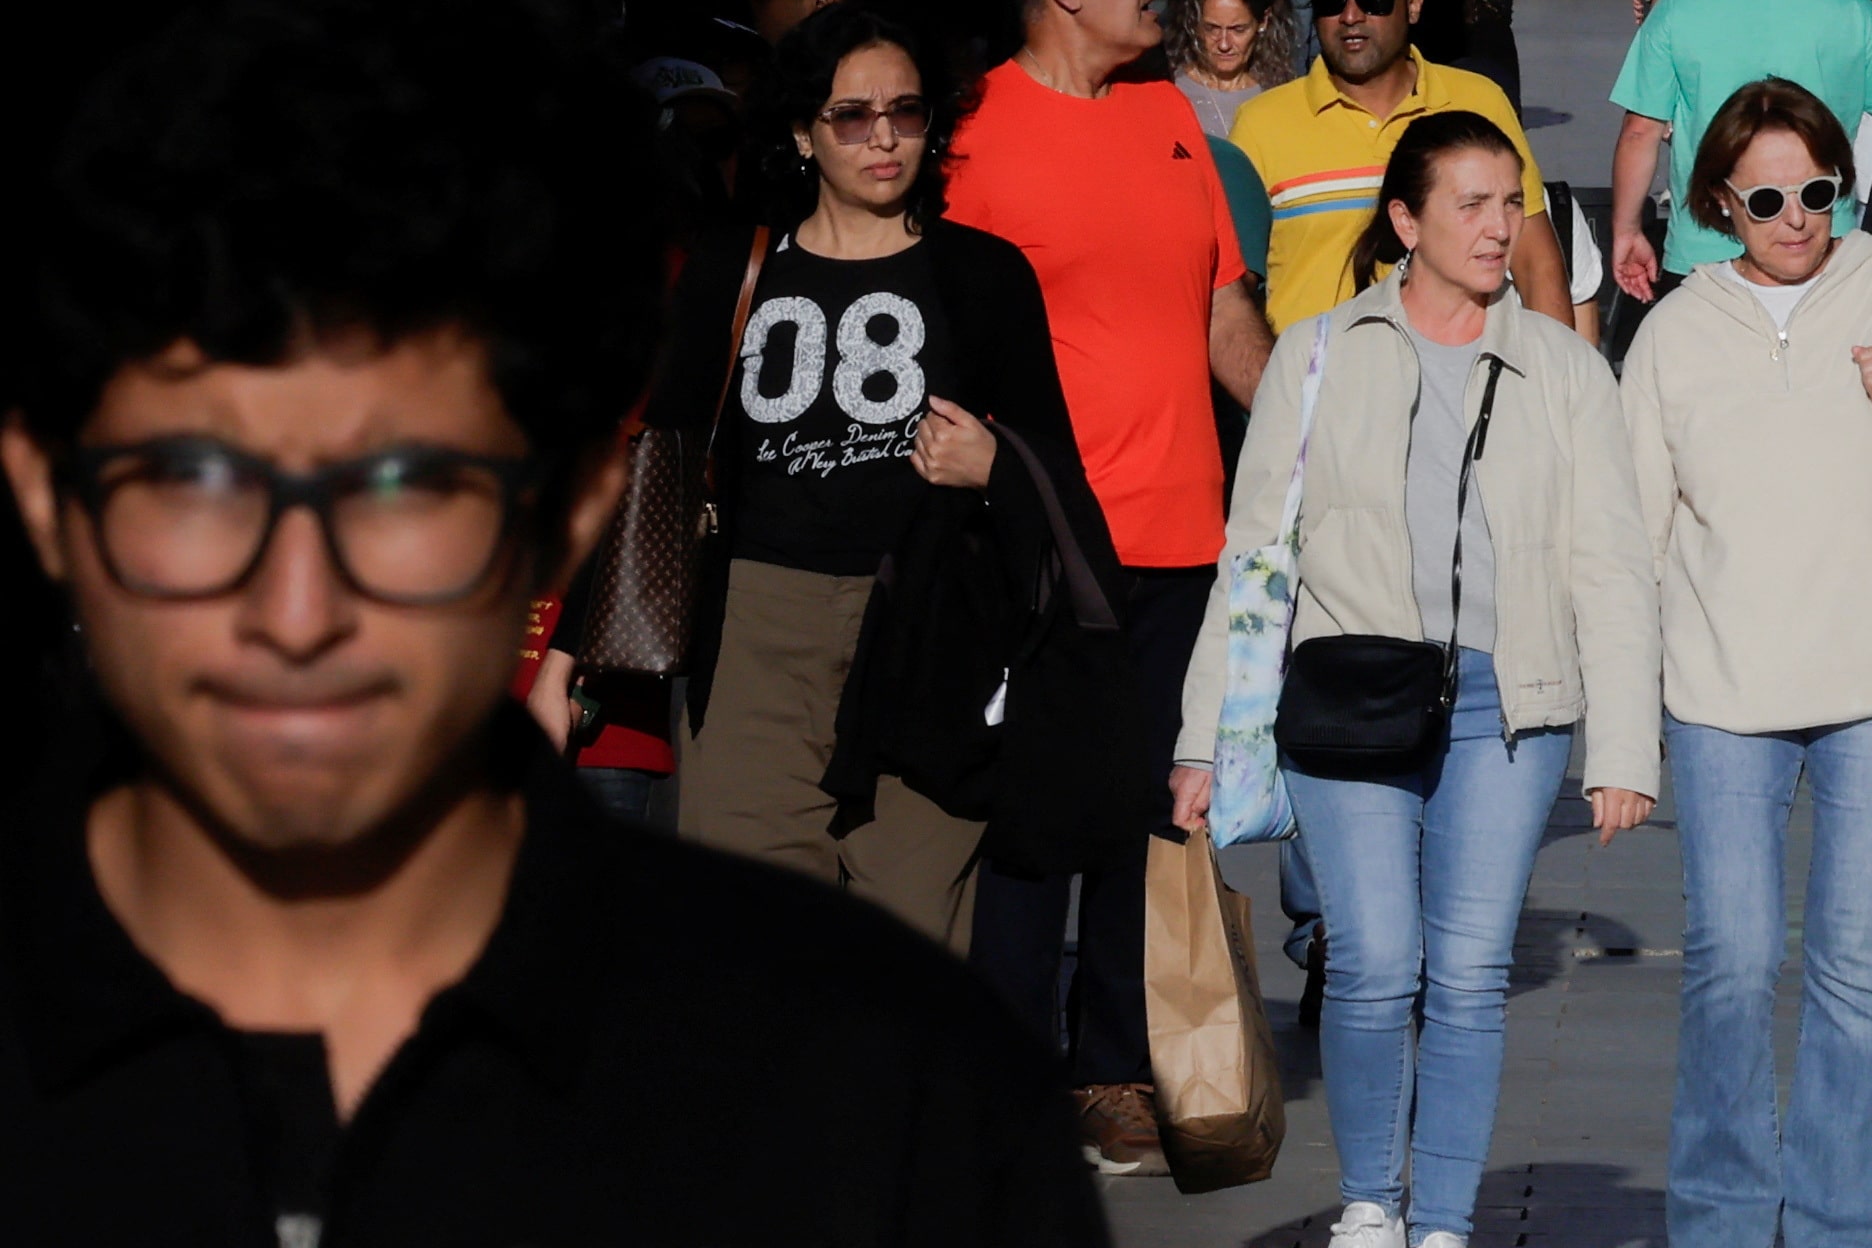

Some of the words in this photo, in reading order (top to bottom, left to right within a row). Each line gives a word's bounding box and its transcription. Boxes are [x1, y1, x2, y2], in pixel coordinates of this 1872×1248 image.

[739, 291, 926, 424] 08
[756, 438, 777, 463] Lee
[782, 430, 834, 457] Cooper
[840, 423, 899, 447] Denim
